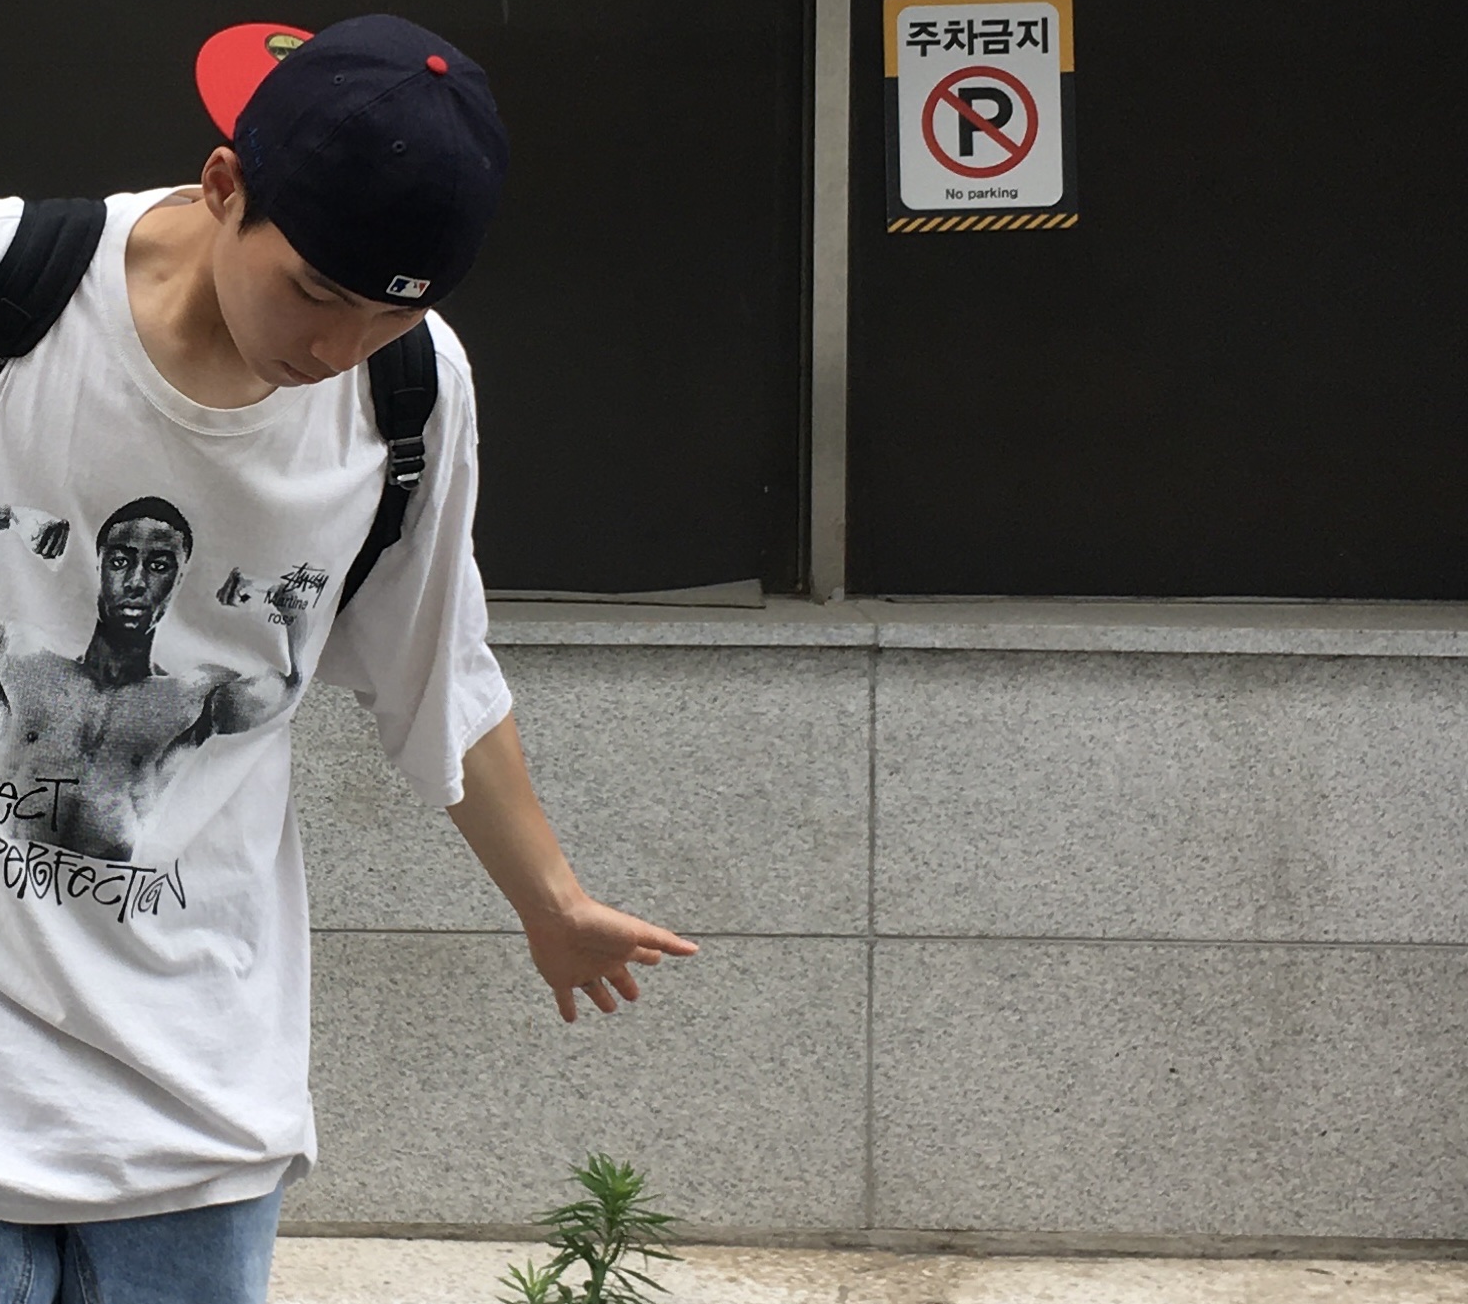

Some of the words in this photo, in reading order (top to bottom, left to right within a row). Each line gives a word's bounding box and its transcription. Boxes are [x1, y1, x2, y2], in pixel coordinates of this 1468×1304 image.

[905, 16, 1049, 58] 주차금지
[945, 188, 964, 200] No
[968, 187, 1019, 201] parking
